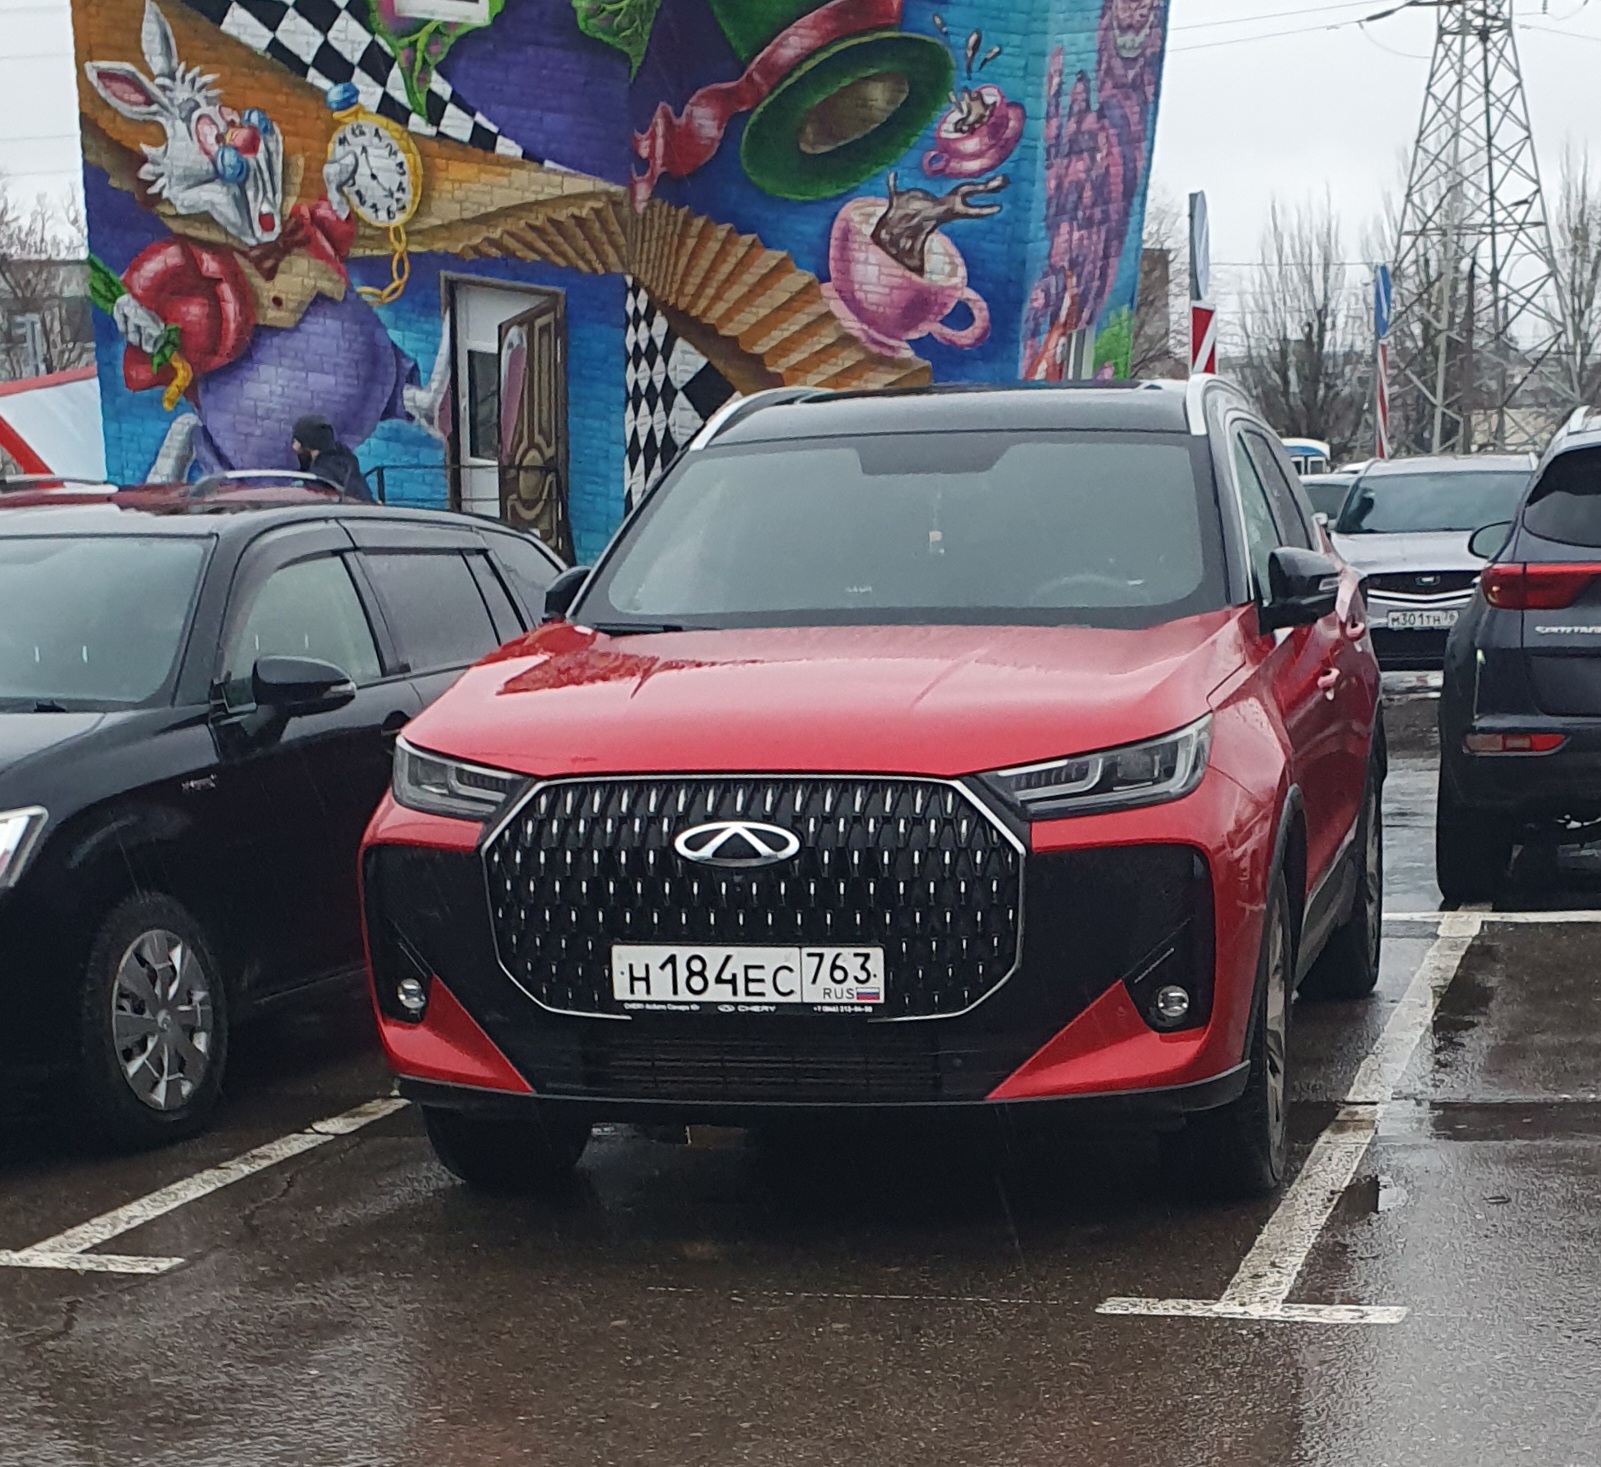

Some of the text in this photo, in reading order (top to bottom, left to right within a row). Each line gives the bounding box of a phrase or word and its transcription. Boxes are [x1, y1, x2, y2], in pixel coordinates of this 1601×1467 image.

[385, 142, 398, 158] 2
[396, 161, 407, 176] 3
[396, 180, 406, 194] 4
[386, 205, 396, 220] 6
[628, 952, 872, 997] Н184ЕС 763
[823, 988, 855, 1000] RUS
[737, 1005, 776, 1013] CHERY
